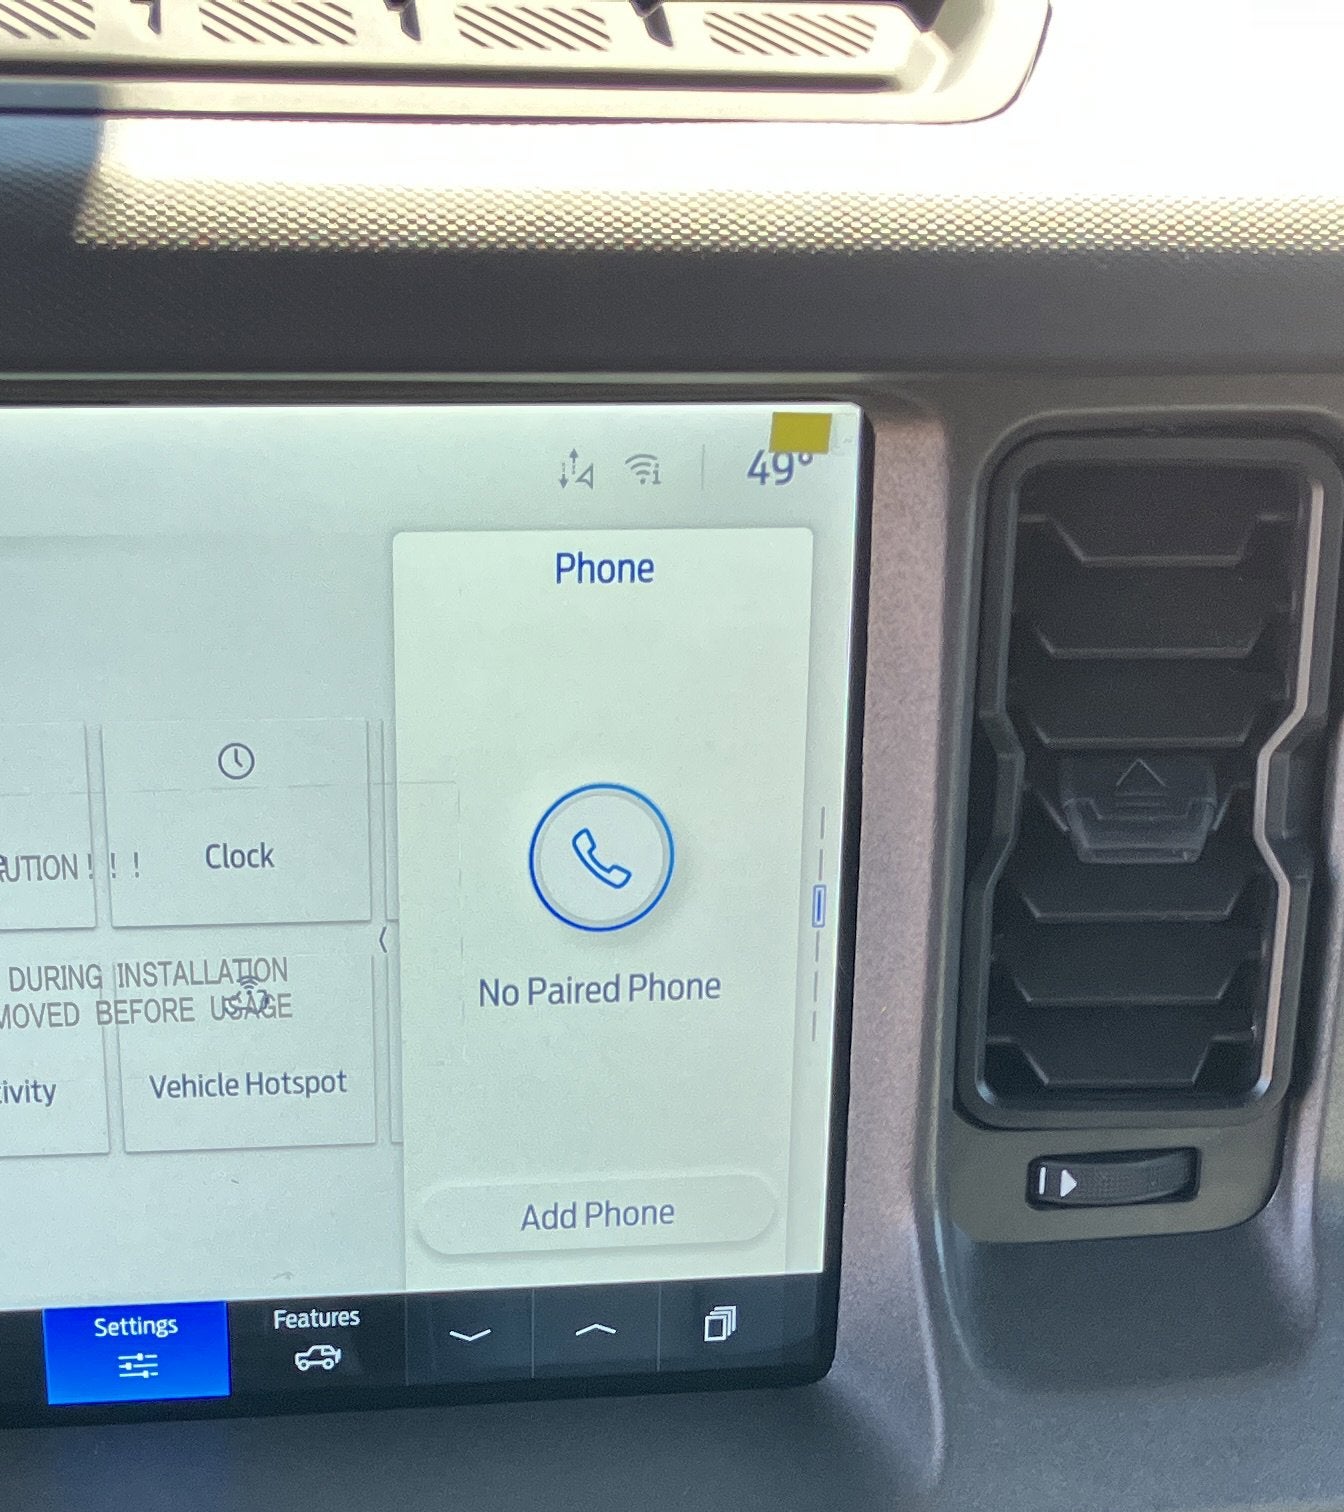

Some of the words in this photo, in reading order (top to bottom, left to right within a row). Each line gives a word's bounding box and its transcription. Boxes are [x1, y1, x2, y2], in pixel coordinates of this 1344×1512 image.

[554, 551, 655, 585] Phone
[205, 842, 275, 870] Clock
[8, 963, 103, 993] DURING
[116, 956, 289, 989] INSTALLATION
[477, 977, 521, 1006] No
[527, 974, 622, 1005] Paired
[626, 972, 722, 1003] Phone
[95, 997, 196, 1027] BEFORE
[210, 992, 294, 1022] USAGE
[148, 1073, 240, 1100] Vehicle
[245, 1069, 348, 1100] Hotspot
[520, 1202, 578, 1231] Add
[583, 1199, 676, 1229] Phone
[93, 1314, 179, 1342] Settings
[273, 1305, 362, 1331] Features
